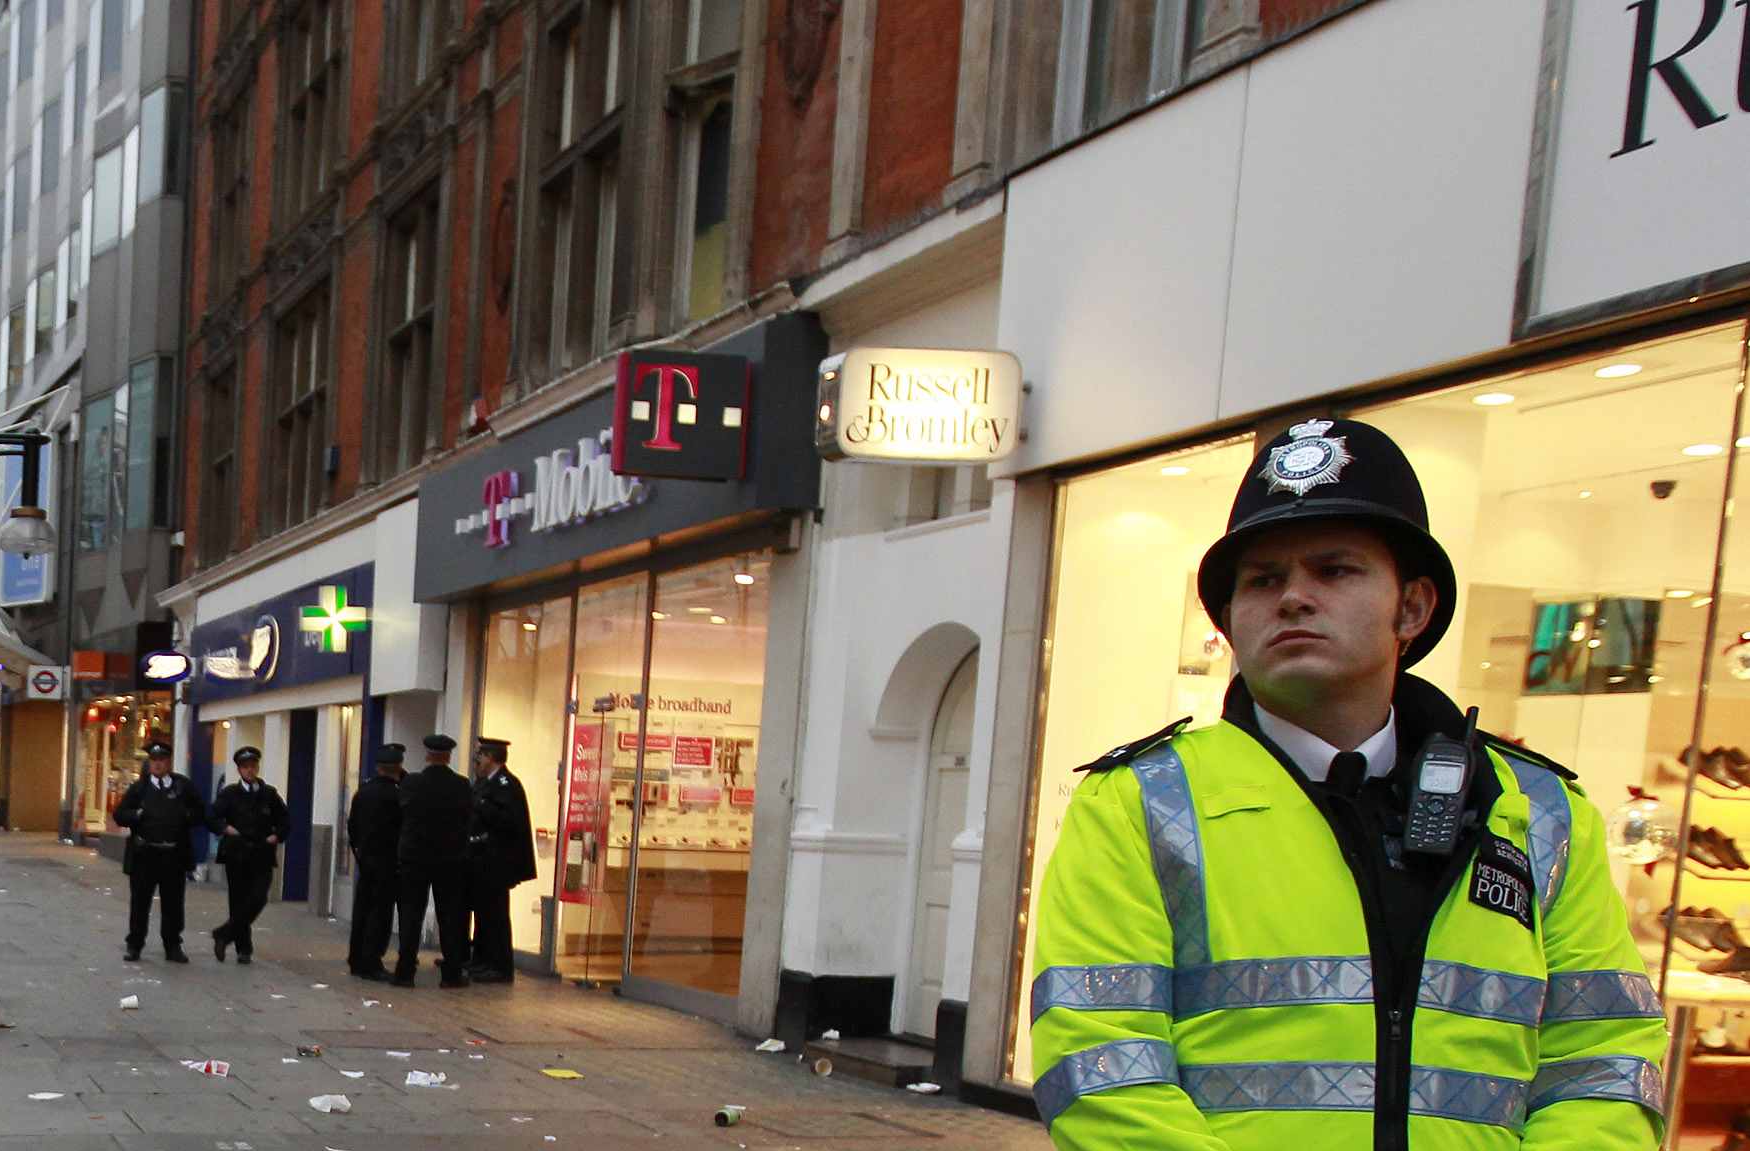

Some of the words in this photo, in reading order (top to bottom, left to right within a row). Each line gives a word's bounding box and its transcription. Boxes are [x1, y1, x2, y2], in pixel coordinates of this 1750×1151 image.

[1610, 0, 1750, 159] R
[633, 362, 699, 450] T
[869, 363, 990, 405] Russell
[847, 415, 871, 444] &
[869, 404, 1008, 453] Bromley
[658, 695, 731, 714] broadband
